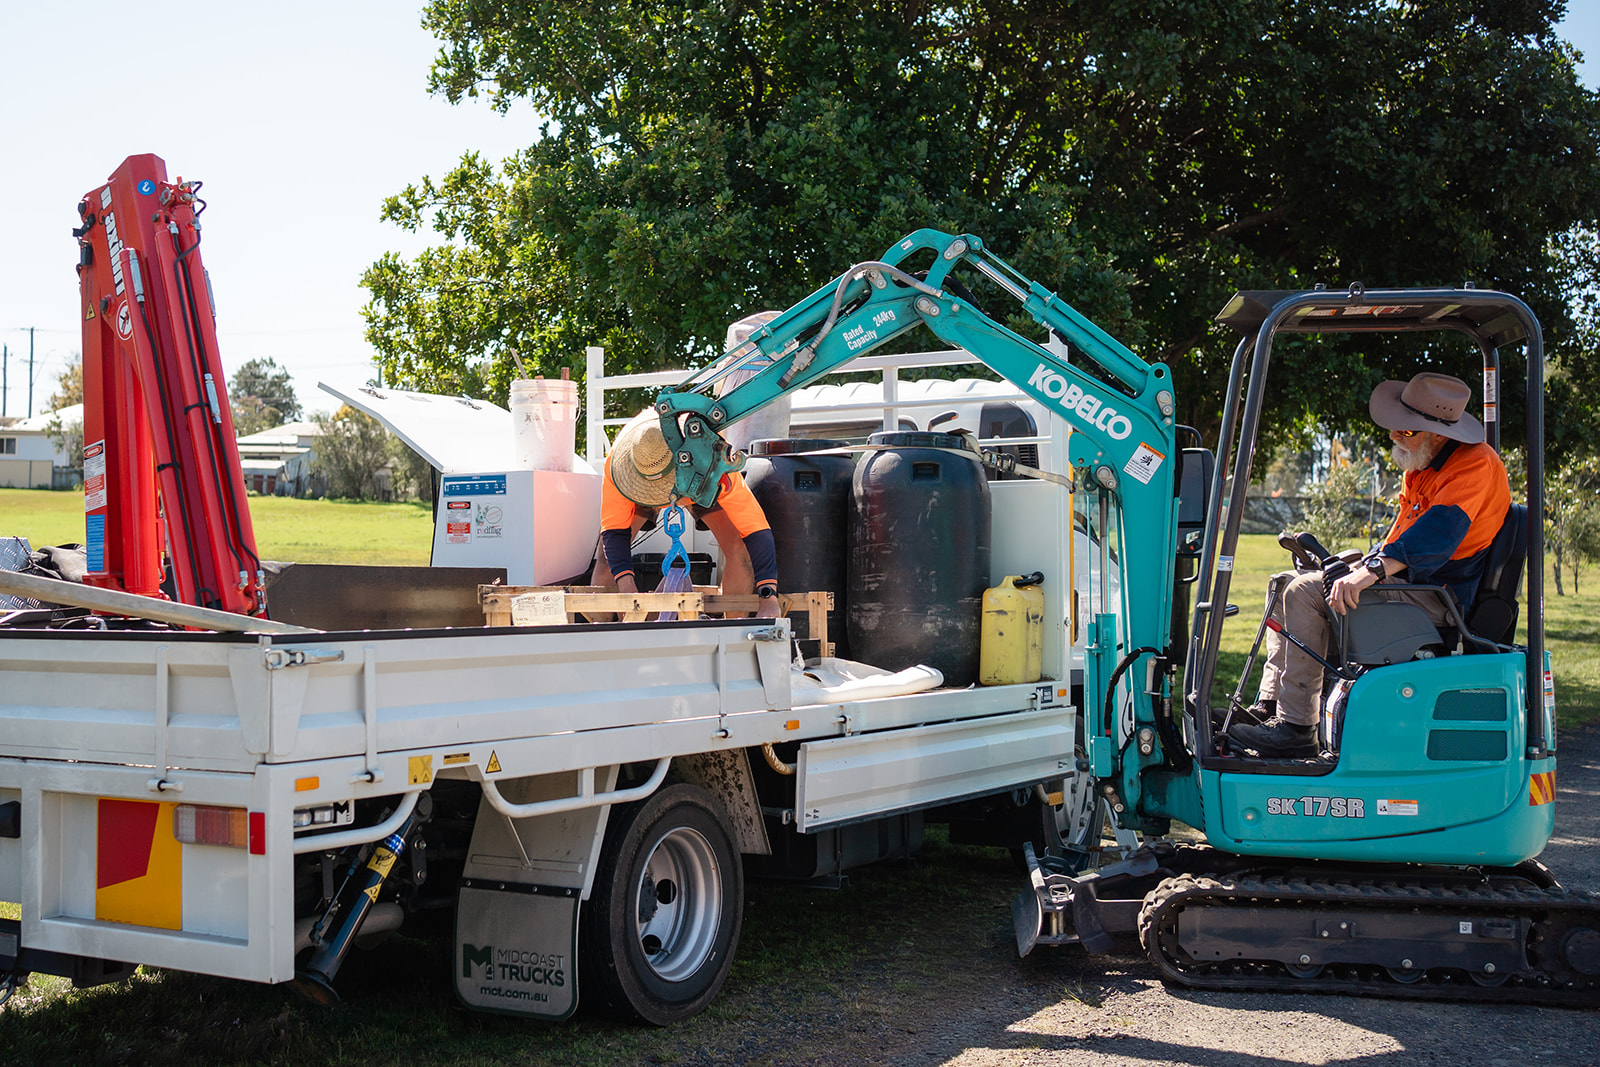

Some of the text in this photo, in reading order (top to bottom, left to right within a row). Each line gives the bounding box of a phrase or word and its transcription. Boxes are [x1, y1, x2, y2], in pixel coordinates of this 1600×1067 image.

[872, 309, 896, 328] 244kg
[842, 324, 865, 342] Rated
[847, 329, 878, 351] Capacity
[1027, 363, 1132, 440] KOBELCO
[498, 949, 564, 969] MIDCOAST
[498, 963, 565, 987] TRUCKS
[480, 985, 549, 1003] mct.com.au
